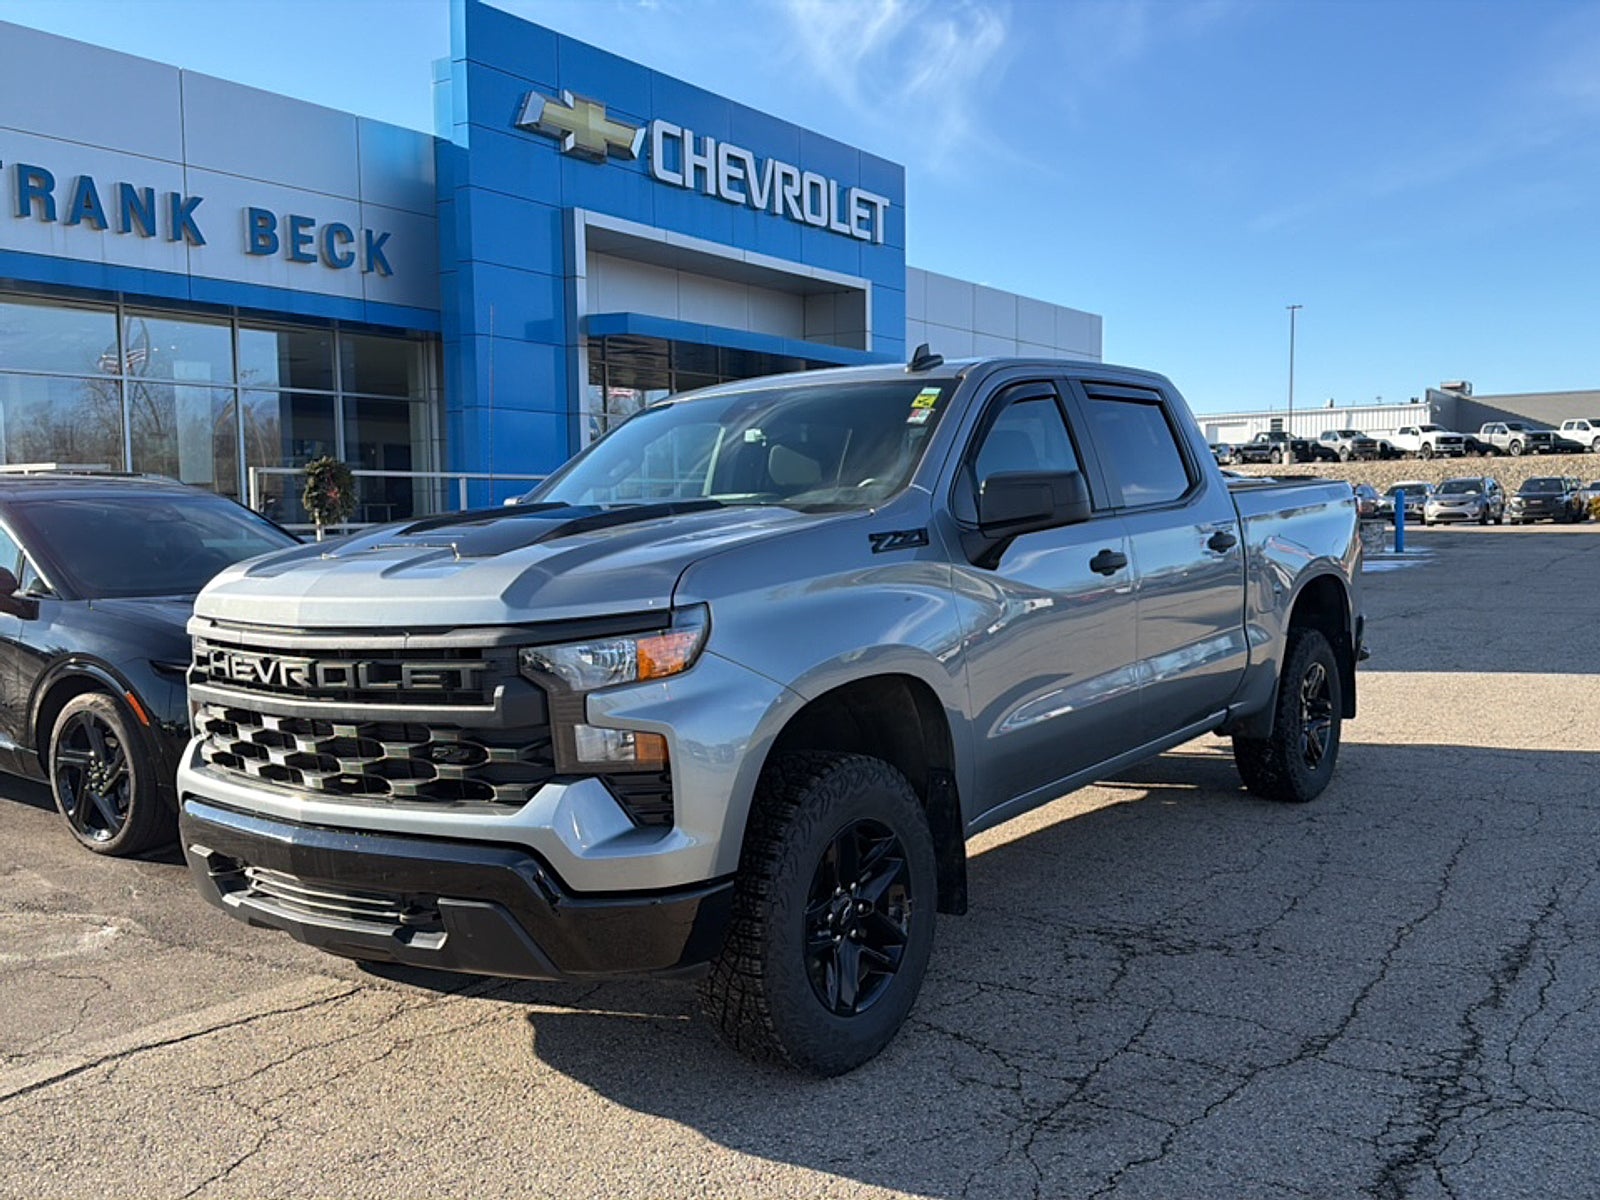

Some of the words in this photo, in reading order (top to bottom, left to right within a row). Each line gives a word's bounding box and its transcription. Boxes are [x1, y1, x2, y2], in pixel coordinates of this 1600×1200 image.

[0, 161, 206, 247] RANK
[243, 206, 393, 276] BECK
[650, 119, 890, 244] CHEVROLET
